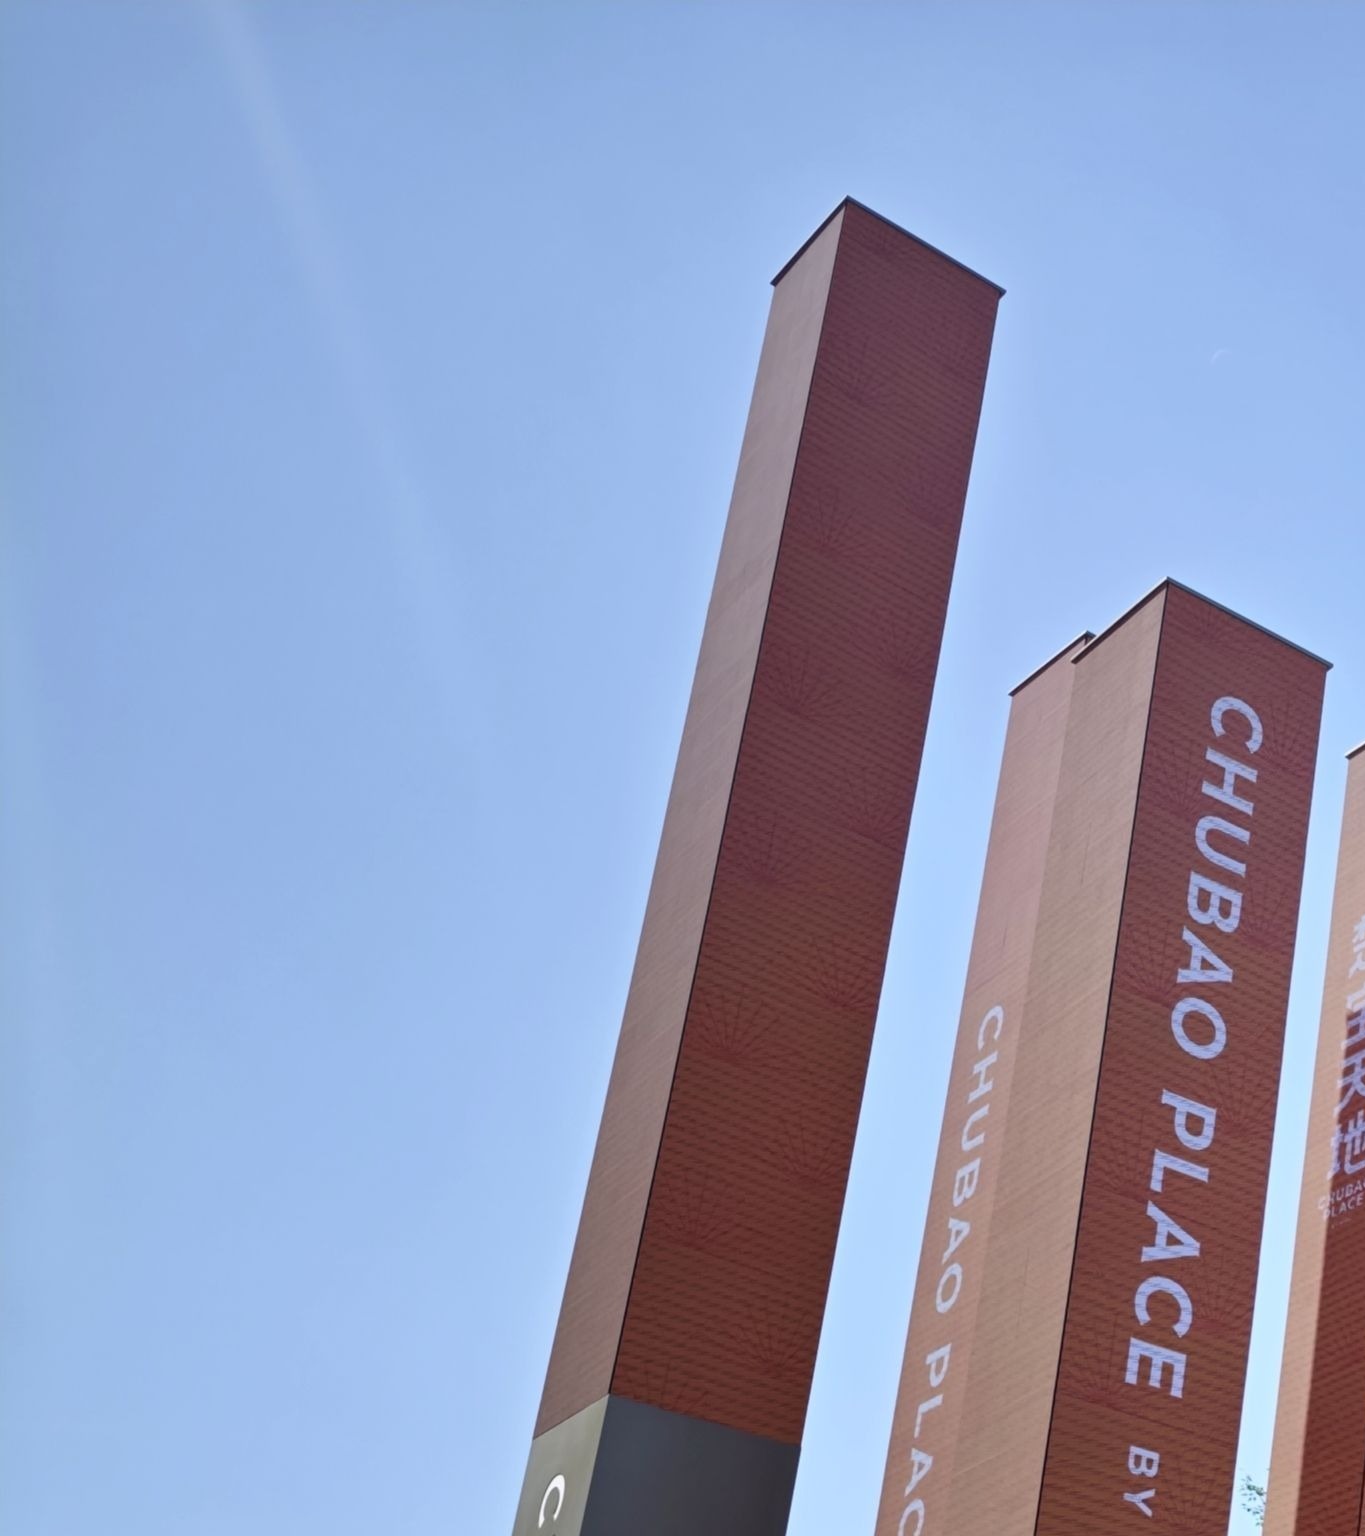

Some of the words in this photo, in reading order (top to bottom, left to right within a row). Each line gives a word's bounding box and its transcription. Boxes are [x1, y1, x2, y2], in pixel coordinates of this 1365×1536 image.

[1170, 695, 1264, 1061] CHUBAO
[935, 1004, 1004, 1314] CHUBAO
[1124, 1088, 1218, 1400] PLACE
[1124, 1444, 1161, 1518] BY
